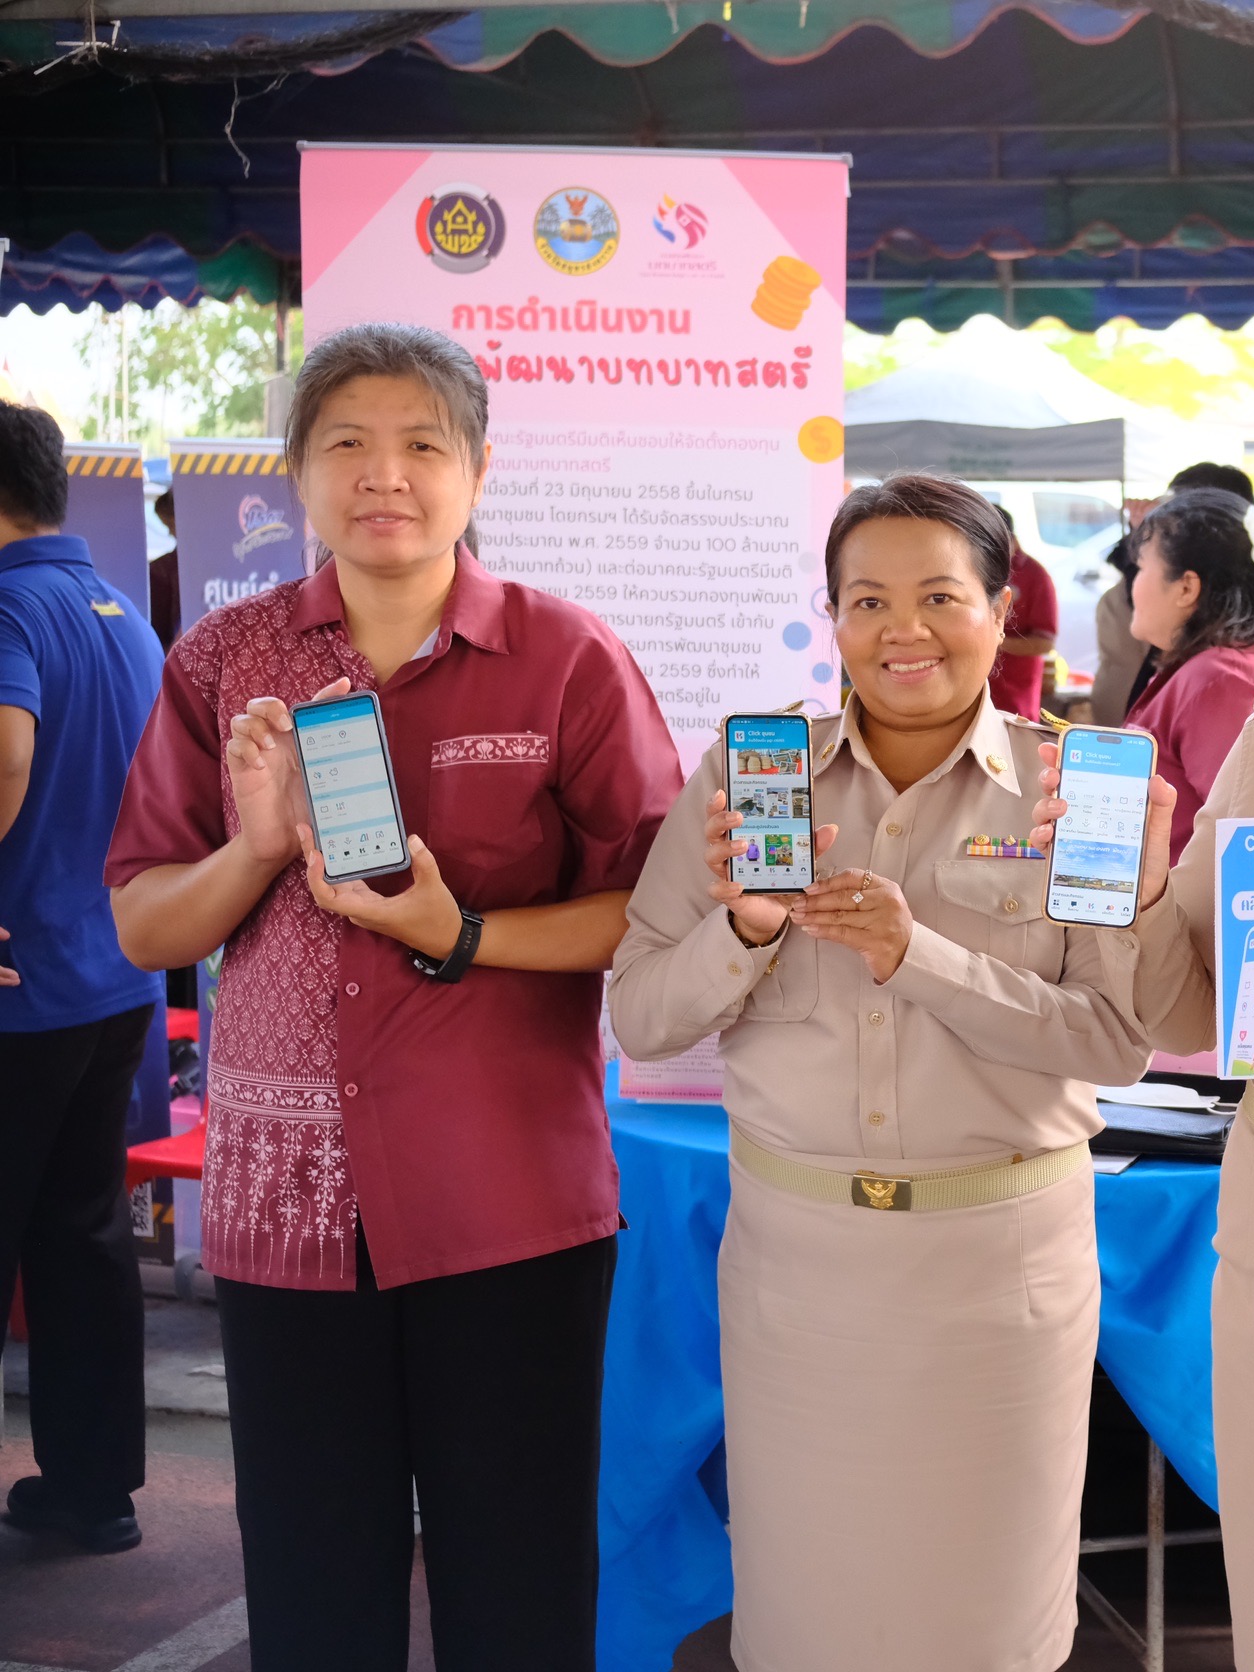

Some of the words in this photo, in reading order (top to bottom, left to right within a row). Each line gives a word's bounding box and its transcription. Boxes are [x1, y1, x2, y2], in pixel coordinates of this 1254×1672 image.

[452, 296, 691, 334] การดำเนินงาน
[544, 482, 565, 497] 23
[570, 481, 632, 501] มิถุนายน
[638, 484, 681, 500] 2558
[605, 535, 649, 550] 2559
[654, 534, 701, 551] จำนวน
[706, 537, 737, 552] 100
[742, 536, 800, 553] ล้านบาท
[574, 584, 618, 600] 2559
[623, 638, 762, 657] รมการพัฒนาชุมชน
[659, 663, 702, 679] 2559
[665, 717, 718, 734] าชุมชน
